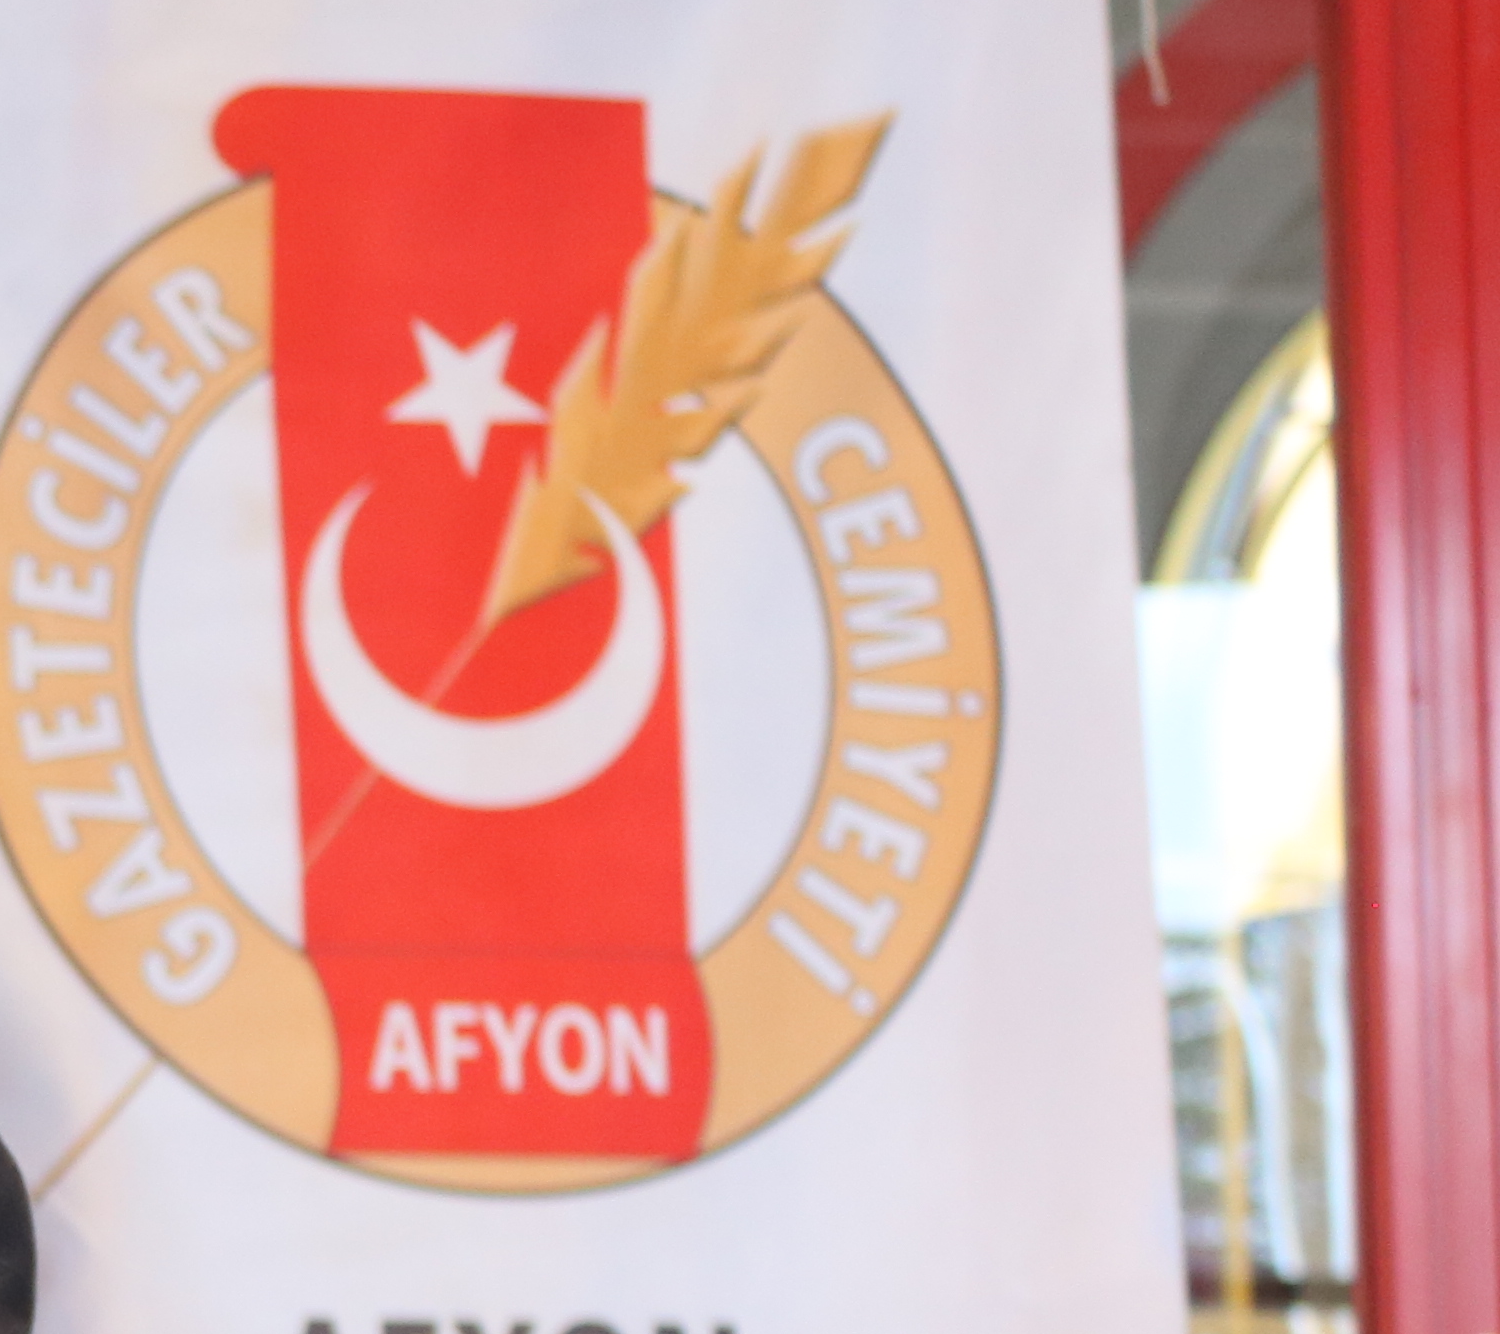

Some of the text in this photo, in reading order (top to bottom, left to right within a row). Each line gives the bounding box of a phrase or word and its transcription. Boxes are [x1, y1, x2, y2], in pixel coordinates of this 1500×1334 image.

[8, 265, 257, 1008] GAZETECİLER
[766, 414, 984, 1017] CEMİYETİ
[368, 999, 672, 1098] AFYON
